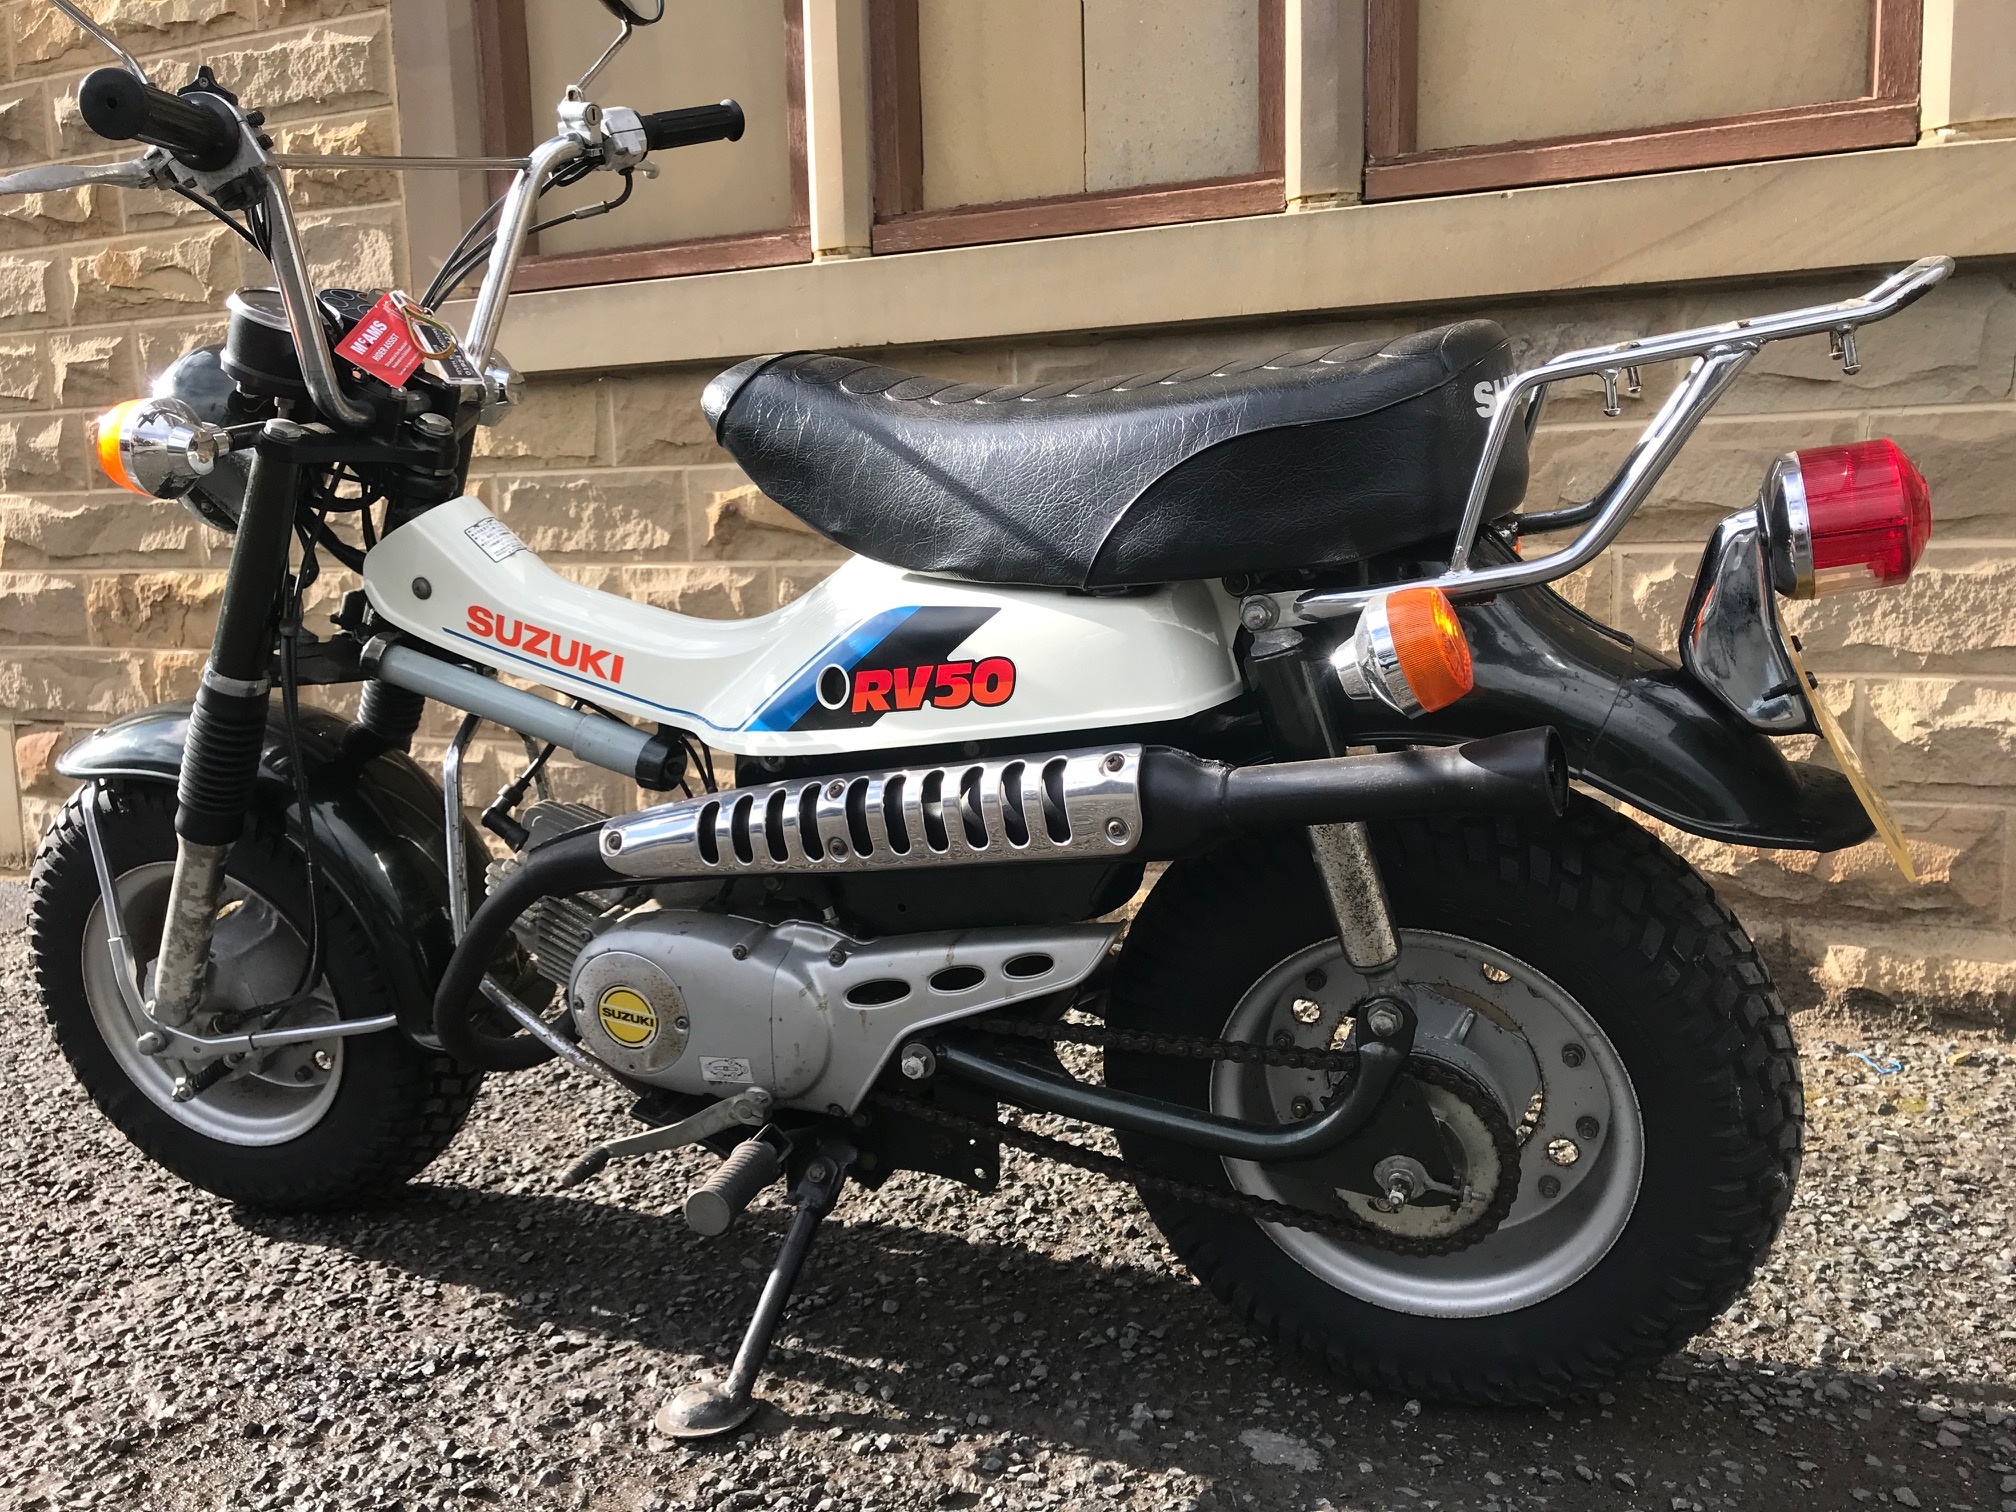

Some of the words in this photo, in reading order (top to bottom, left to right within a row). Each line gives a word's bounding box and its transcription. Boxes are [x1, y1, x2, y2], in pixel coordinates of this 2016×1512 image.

[372, 343, 387, 361] RIDER
[384, 333, 399, 349] ASSIST
[467, 605, 624, 684] SUZUKI
[851, 656, 1016, 713] RV50
[602, 1008, 654, 1027] SUZUKI
